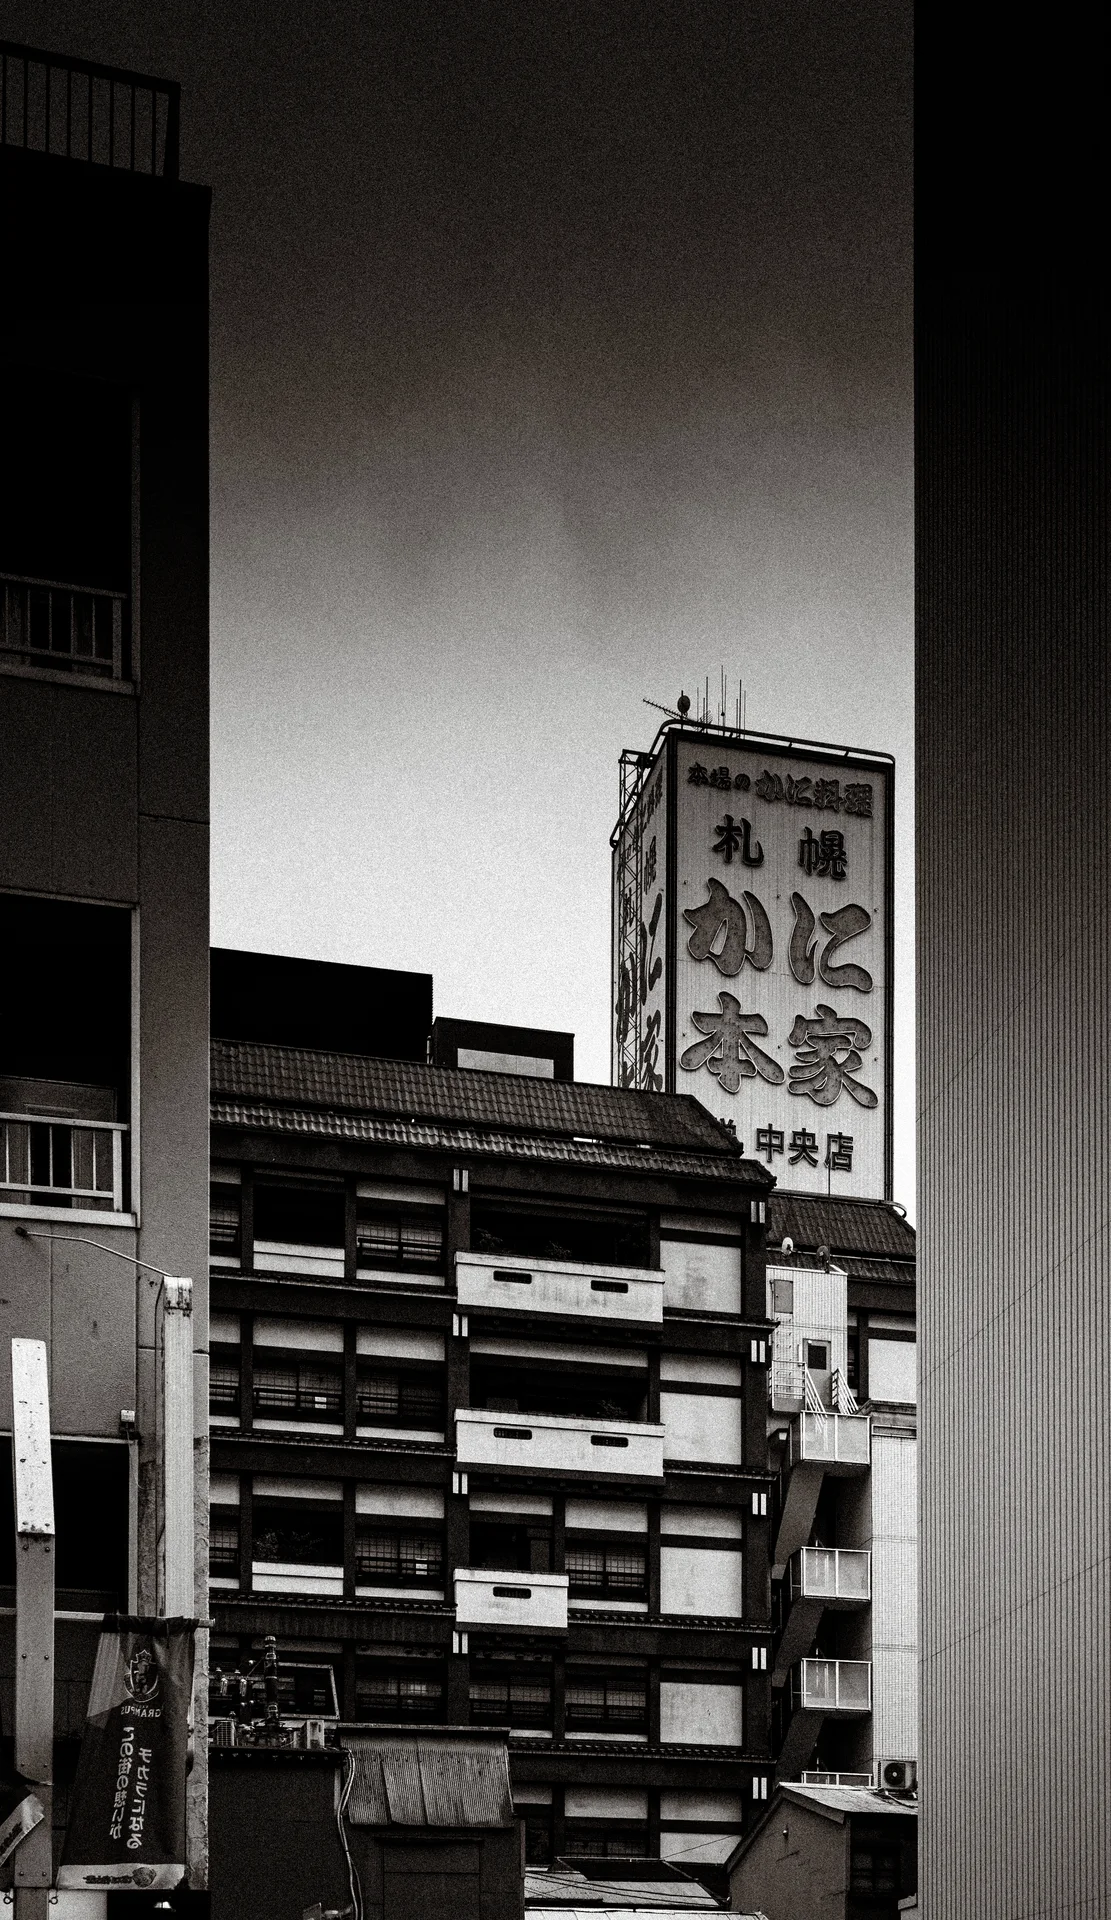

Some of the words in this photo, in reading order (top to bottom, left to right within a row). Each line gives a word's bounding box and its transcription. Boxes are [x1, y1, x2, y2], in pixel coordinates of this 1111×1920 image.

[686, 761, 874, 817] 本場のかに料理
[712, 813, 849, 880] 札幌
[682, 876, 874, 993] かに
[679, 991, 879, 1109] 本家
[754, 1122, 854, 1172] 中央店
